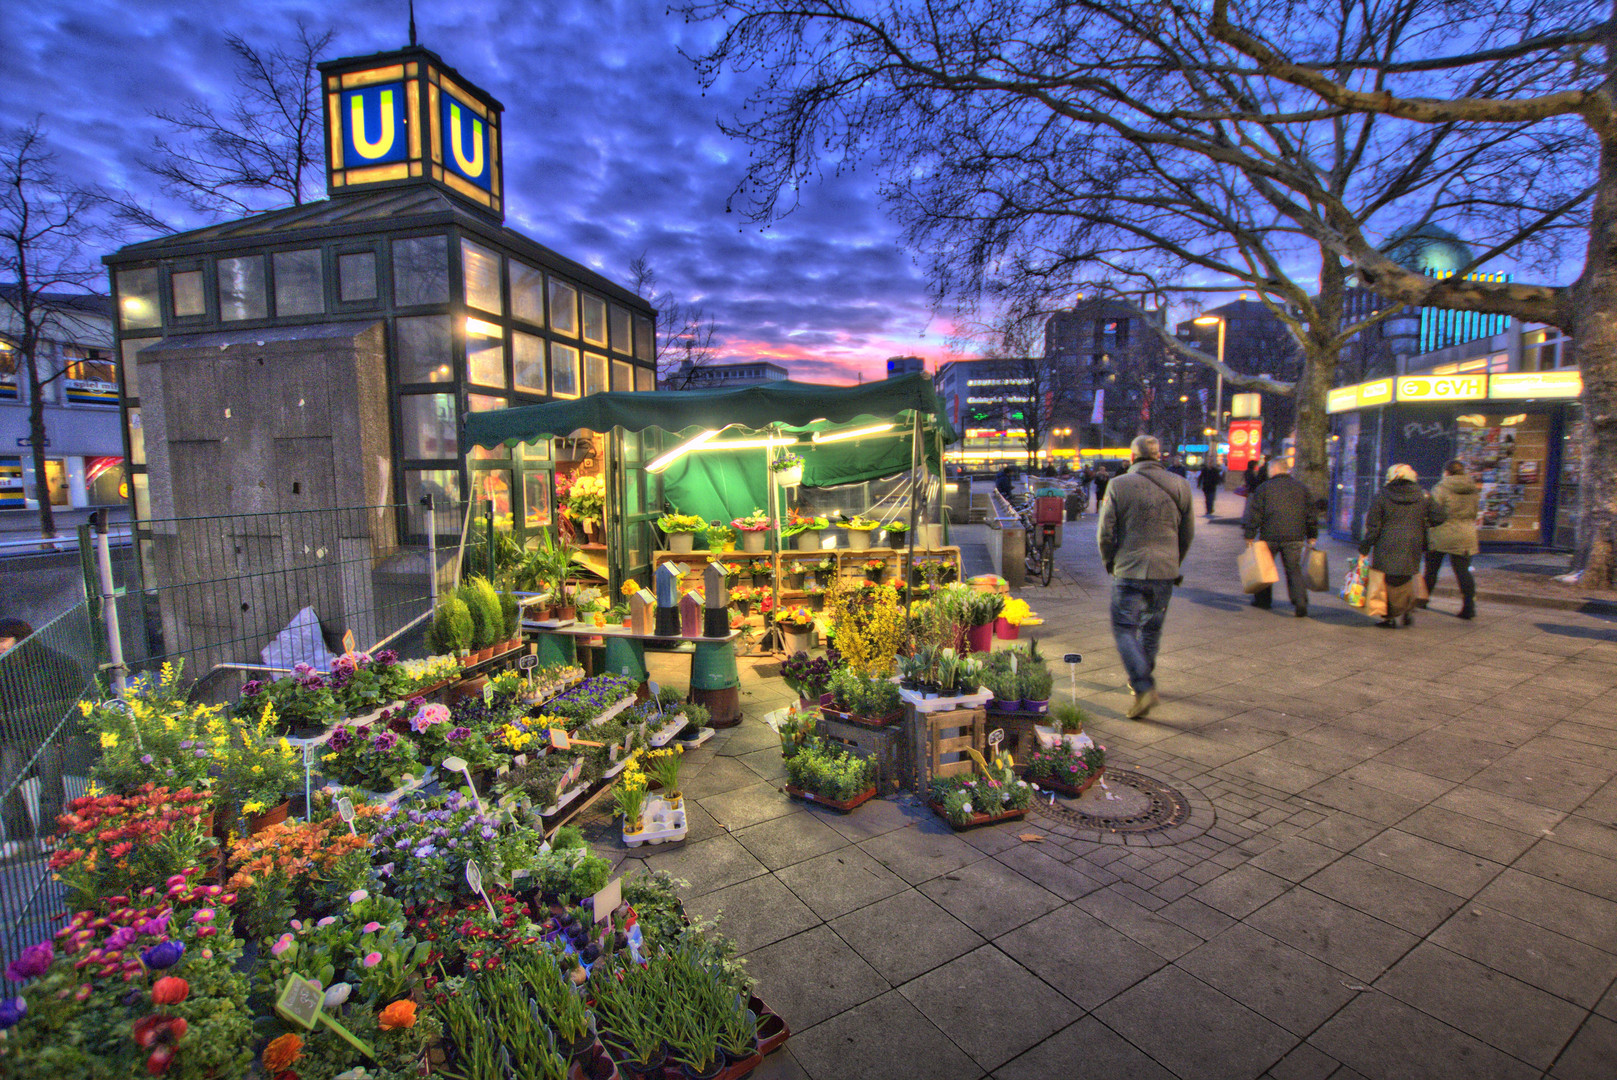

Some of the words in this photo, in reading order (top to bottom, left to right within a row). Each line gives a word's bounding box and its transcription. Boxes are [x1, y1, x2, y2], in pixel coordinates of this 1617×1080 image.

[351, 90, 395, 159] U
[450, 103, 484, 178] U
[73, 381, 99, 389] spiel
[1434, 379, 1482, 396] GVH
